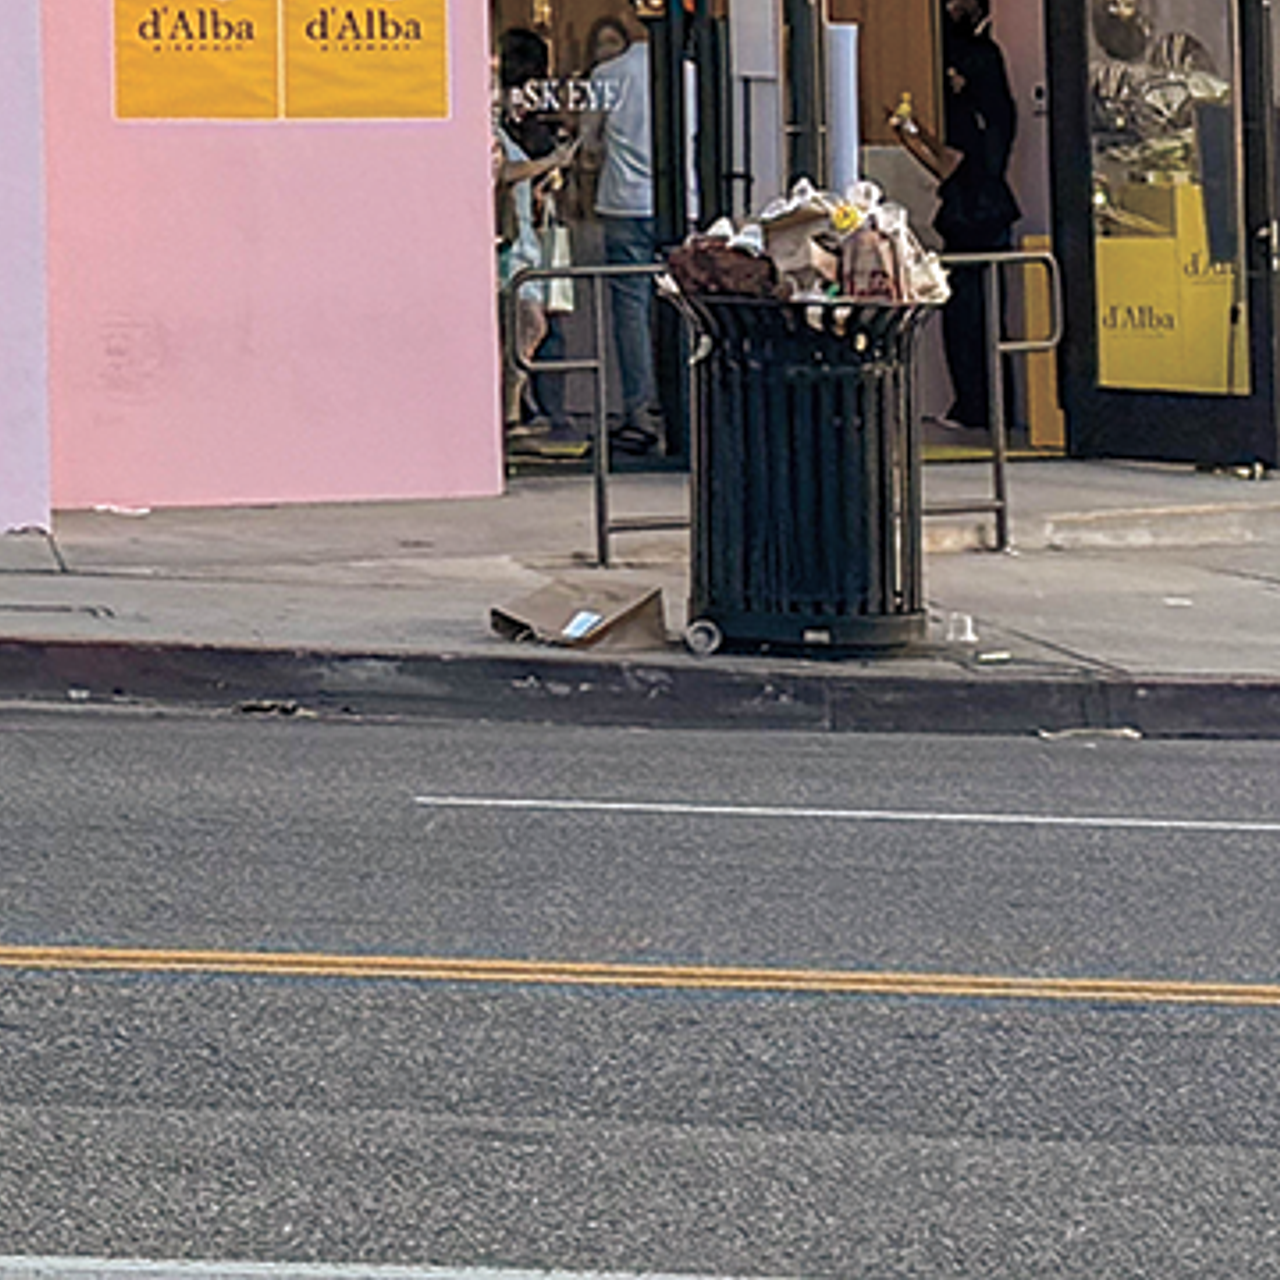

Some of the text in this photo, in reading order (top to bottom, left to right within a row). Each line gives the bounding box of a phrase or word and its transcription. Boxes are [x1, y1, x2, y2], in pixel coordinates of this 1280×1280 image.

[138, 6, 254, 40] d'Alba
[305, 6, 422, 40] d'Alba
[1102, 305, 1175, 330] dAlba
